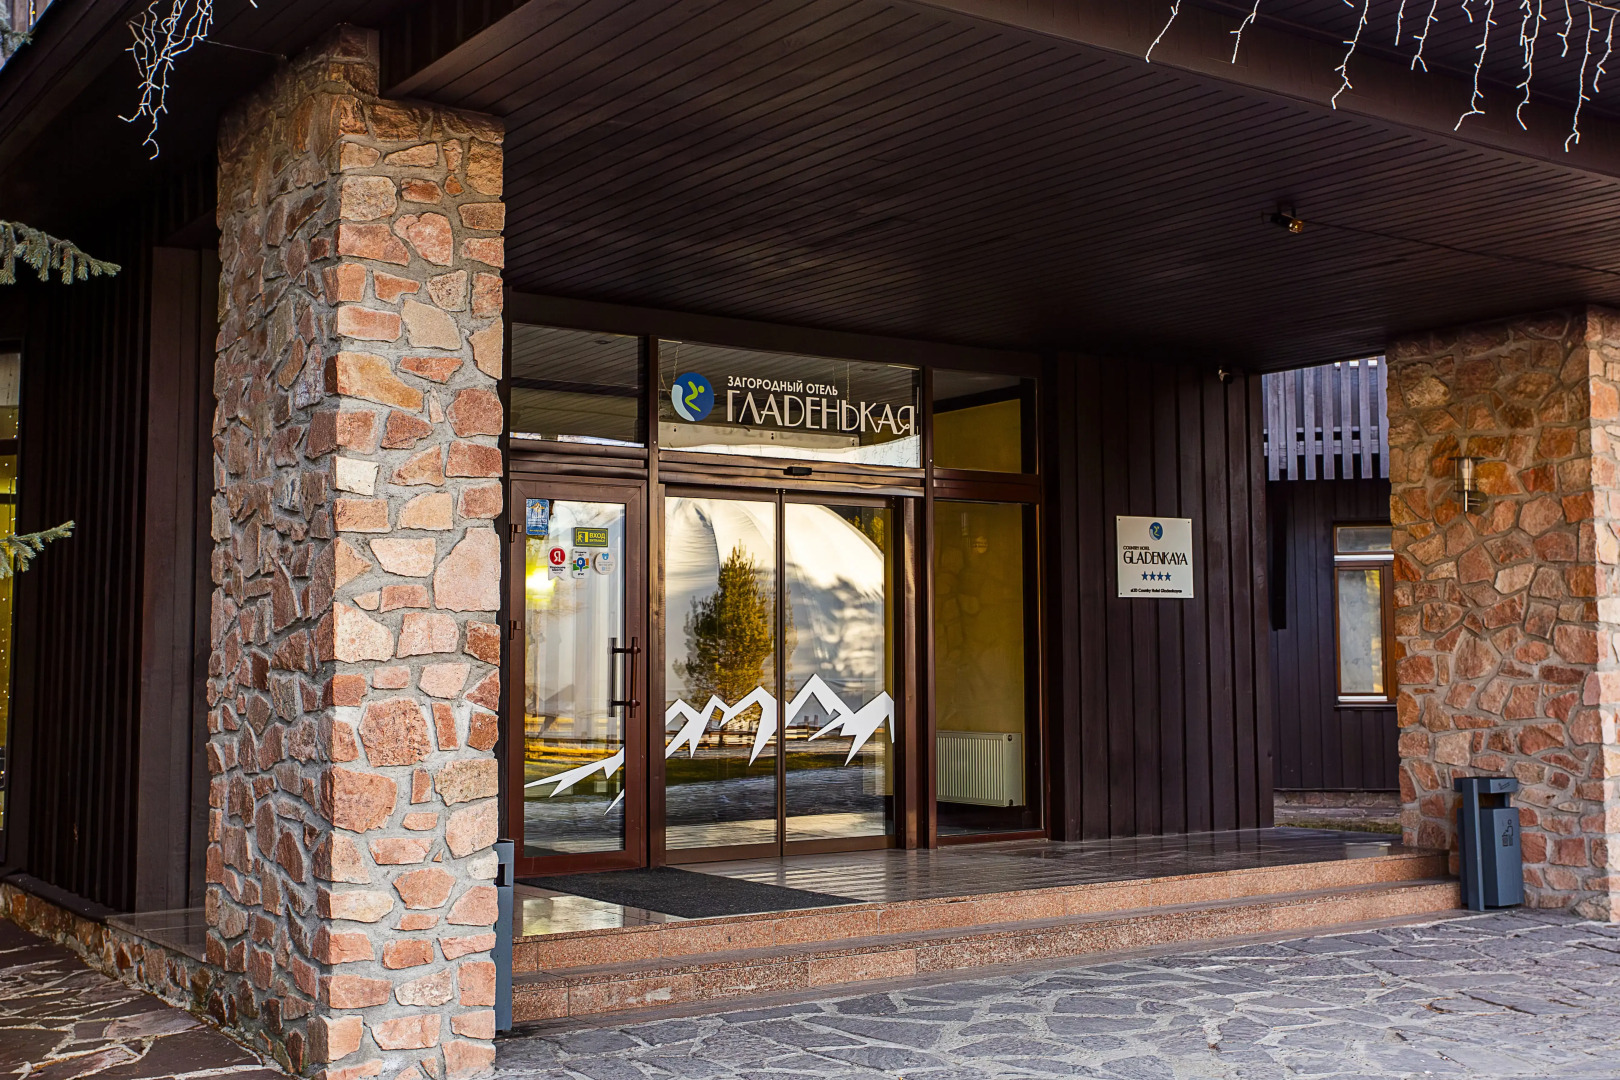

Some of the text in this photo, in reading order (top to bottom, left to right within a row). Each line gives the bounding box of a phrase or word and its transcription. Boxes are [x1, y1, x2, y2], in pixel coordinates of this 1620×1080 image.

[727, 375, 838, 396] ЗАГОРОДНЫЙ ОТЕЛЬ
[589, 532, 605, 540] ВХОД
[554, 551, 563, 562] Я
[1123, 551, 1188, 565] GLADENKAYA
